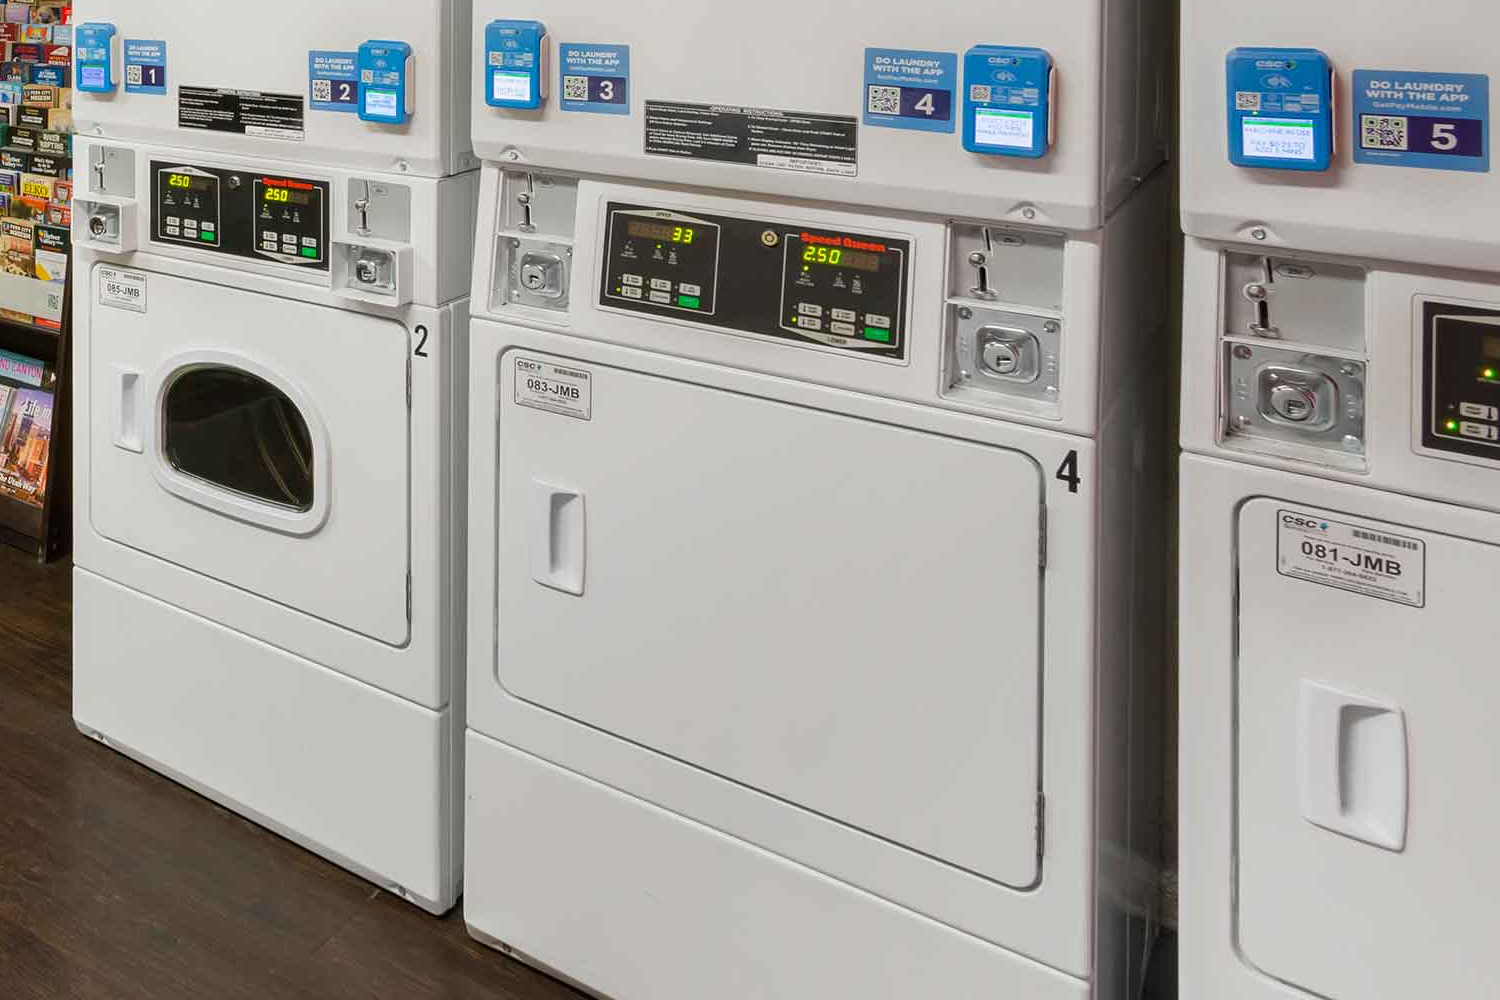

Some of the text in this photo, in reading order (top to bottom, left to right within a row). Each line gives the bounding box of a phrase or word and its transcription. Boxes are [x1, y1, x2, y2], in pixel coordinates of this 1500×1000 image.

[872, 63, 944, 76] WITH THE APP
[875, 56, 941, 68] DO LAUNDRY
[148, 68, 156, 85] 1
[339, 83, 351, 101] 2
[599, 80, 613, 101] 3
[1365, 89, 1470, 102] WITH THE APP
[1369, 80, 1464, 93] DO LAUNDRY
[913, 92, 935, 116] 4
[1430, 123, 1458, 151] 5
[24, 184, 49, 196] ELKO
[671, 226, 693, 245] 33
[800, 232, 885, 252] Speed Queen
[803, 245, 841, 265] 2.50
[414, 324, 428, 358] 2
[516, 360, 536, 370] CSC
[527, 378, 580, 399] 083-JMB
[1055, 450, 1081, 494] 4
[1282, 514, 1317, 529] CSC
[1301, 540, 1402, 576] 081-JMB
